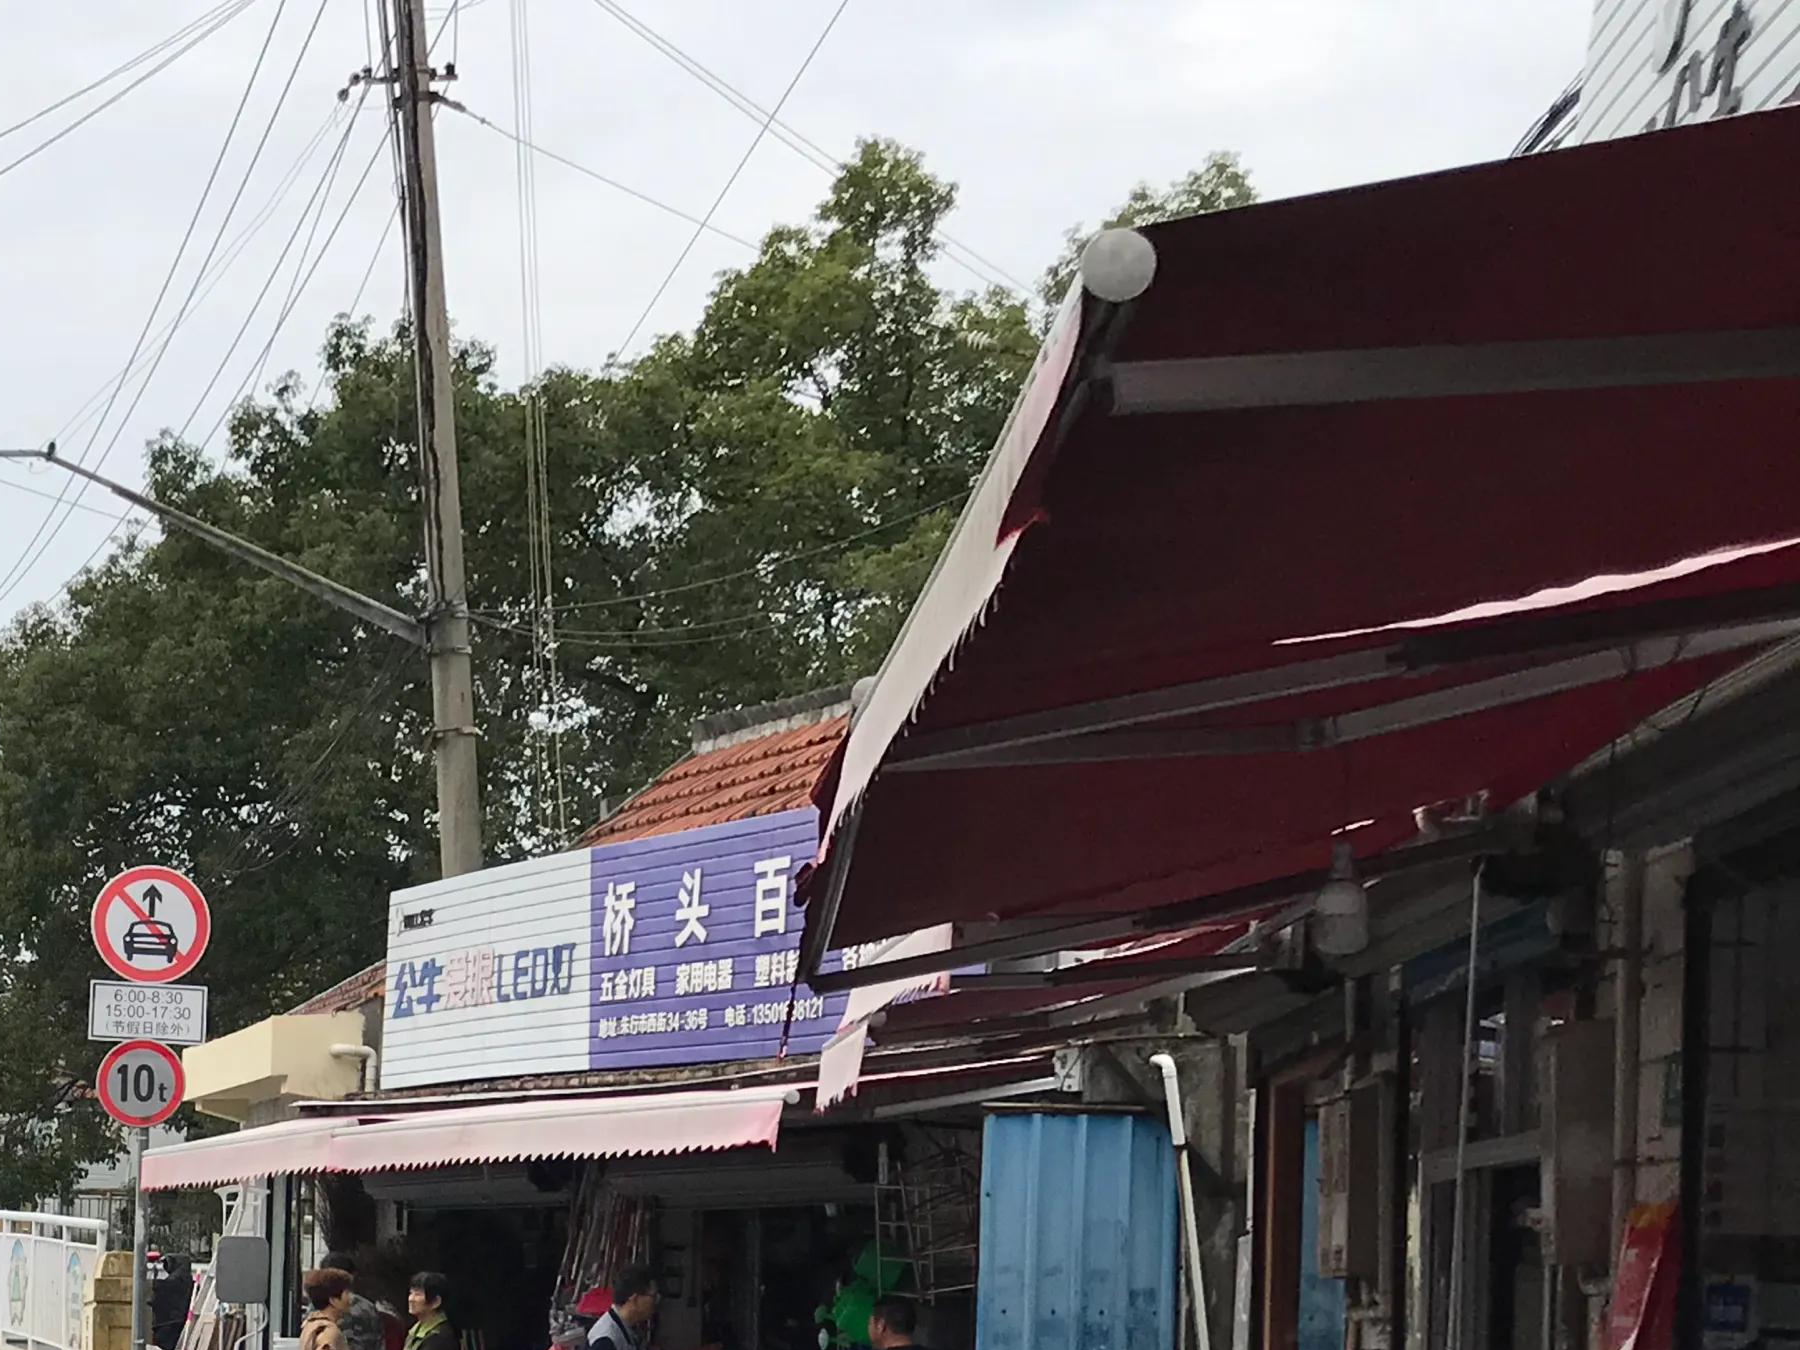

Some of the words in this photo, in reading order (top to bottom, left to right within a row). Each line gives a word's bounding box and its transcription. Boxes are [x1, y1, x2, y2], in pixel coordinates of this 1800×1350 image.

[114, 989, 183, 1005] 6:00-8:30
[392, 943, 577, 1019] 公牛爱眼LED灯
[600, 966, 656, 1002] 五金灯具
[675, 958, 734, 996] 家用电器
[106, 1005, 191, 1020] 15:00-17:30
[117, 1063, 168, 1103] 10t
